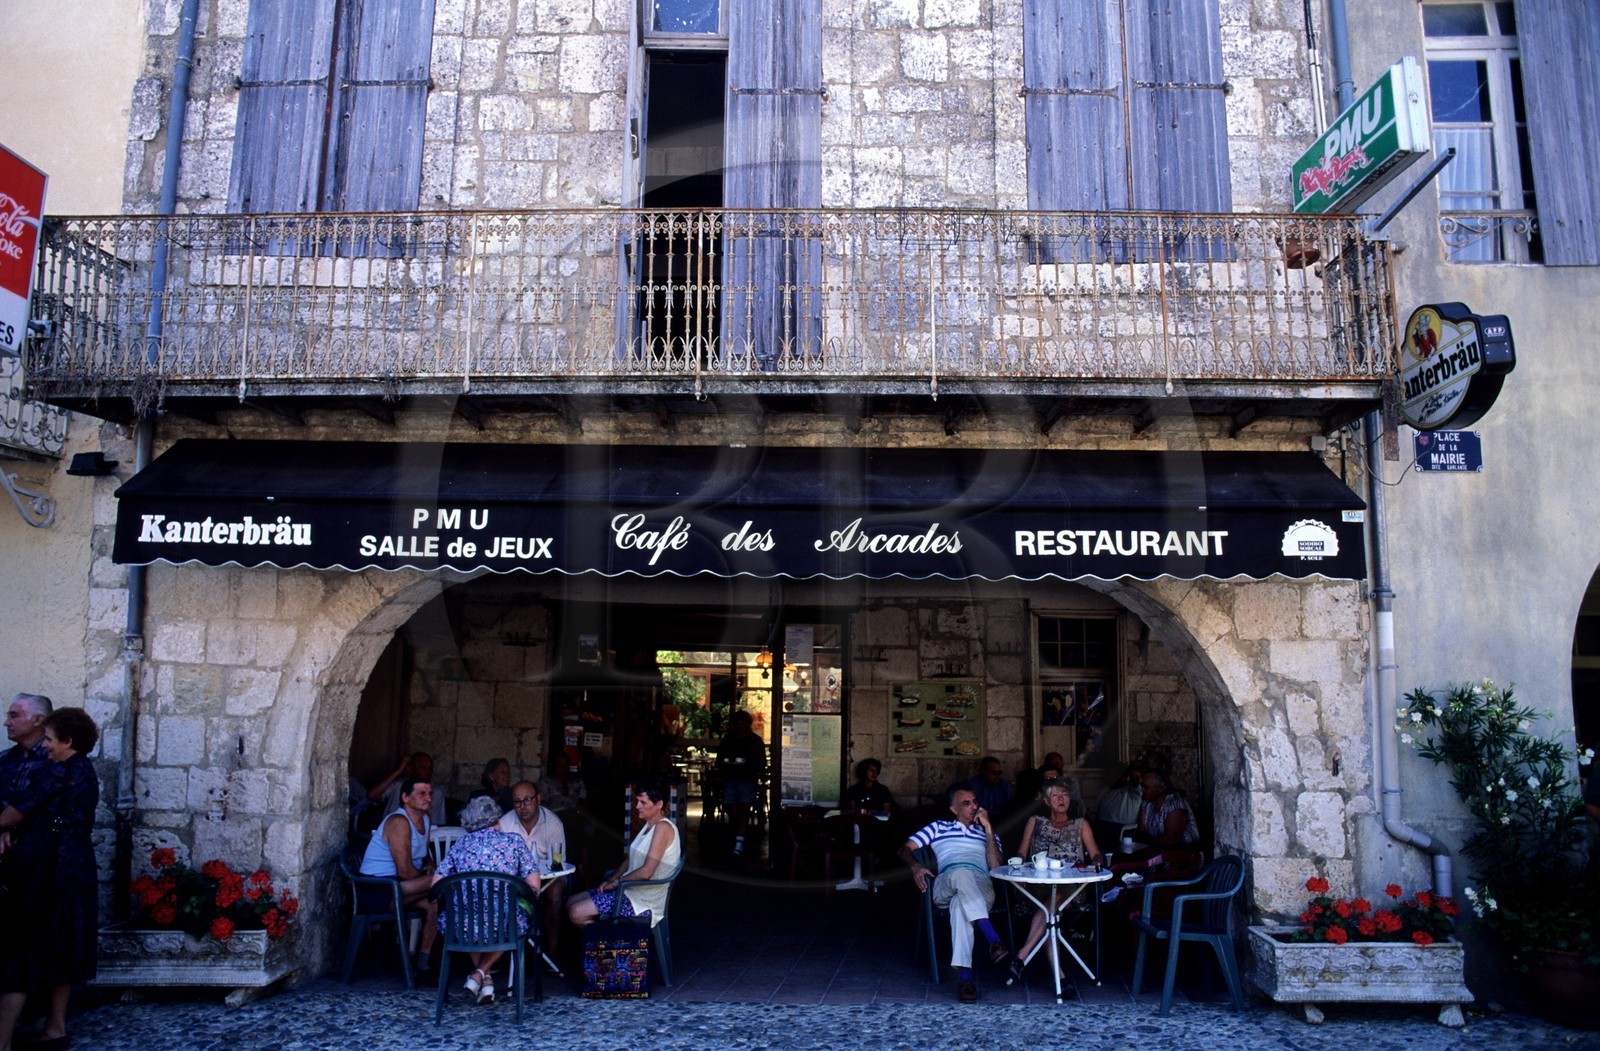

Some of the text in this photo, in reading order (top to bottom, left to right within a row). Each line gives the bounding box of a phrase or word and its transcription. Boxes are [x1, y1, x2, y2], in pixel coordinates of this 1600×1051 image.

[1324, 84, 1382, 166] PMU
[0, 231, 23, 260] oke
[1433, 432, 1461, 442] PLACE
[1431, 453, 1466, 465] MAIRIE
[138, 514, 311, 546] Kanterbräu
[611, 513, 964, 566] Café des Arcades
[1014, 530, 1230, 557] RESTAURANT
[359, 534, 554, 560] SALLE de JEUX
